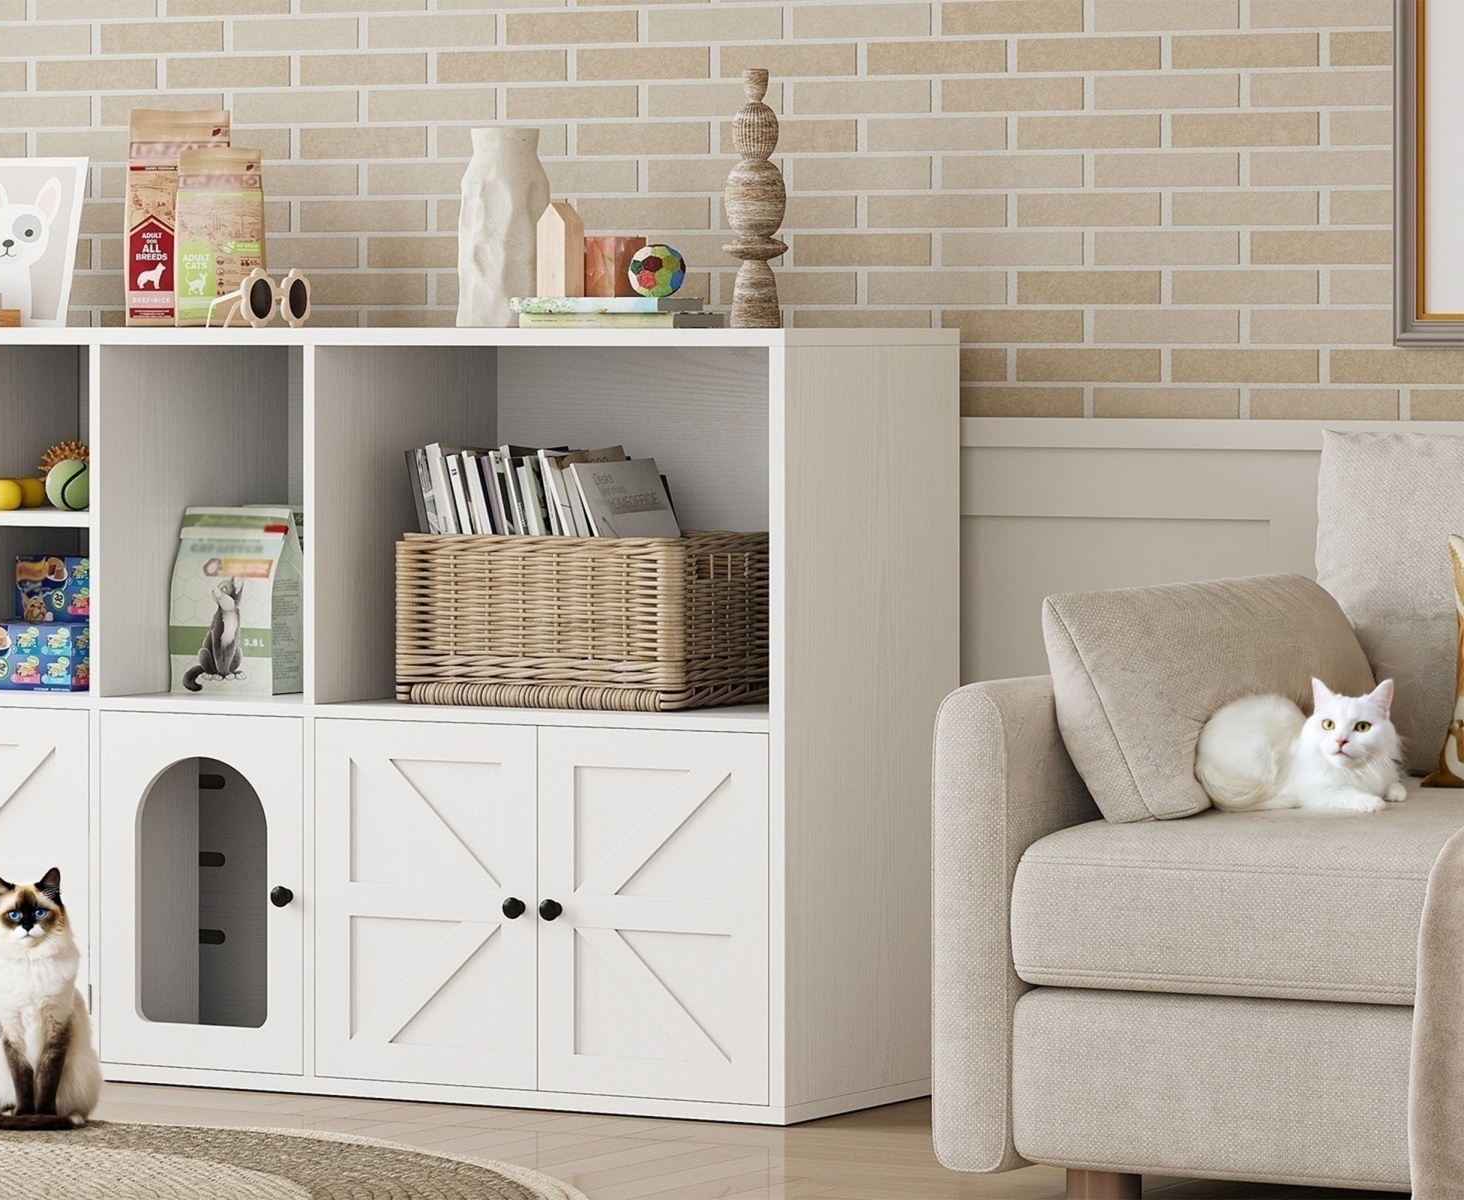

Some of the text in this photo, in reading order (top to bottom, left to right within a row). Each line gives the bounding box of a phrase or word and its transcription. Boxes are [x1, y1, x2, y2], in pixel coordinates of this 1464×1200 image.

[142, 243, 161, 253] ALL
[136, 253, 168, 261] BREEDS
[182, 253, 210, 262] ADULT
[185, 261, 208, 270] CATS
[54, 593, 64, 603] 32
[259, 638, 265, 647] L
